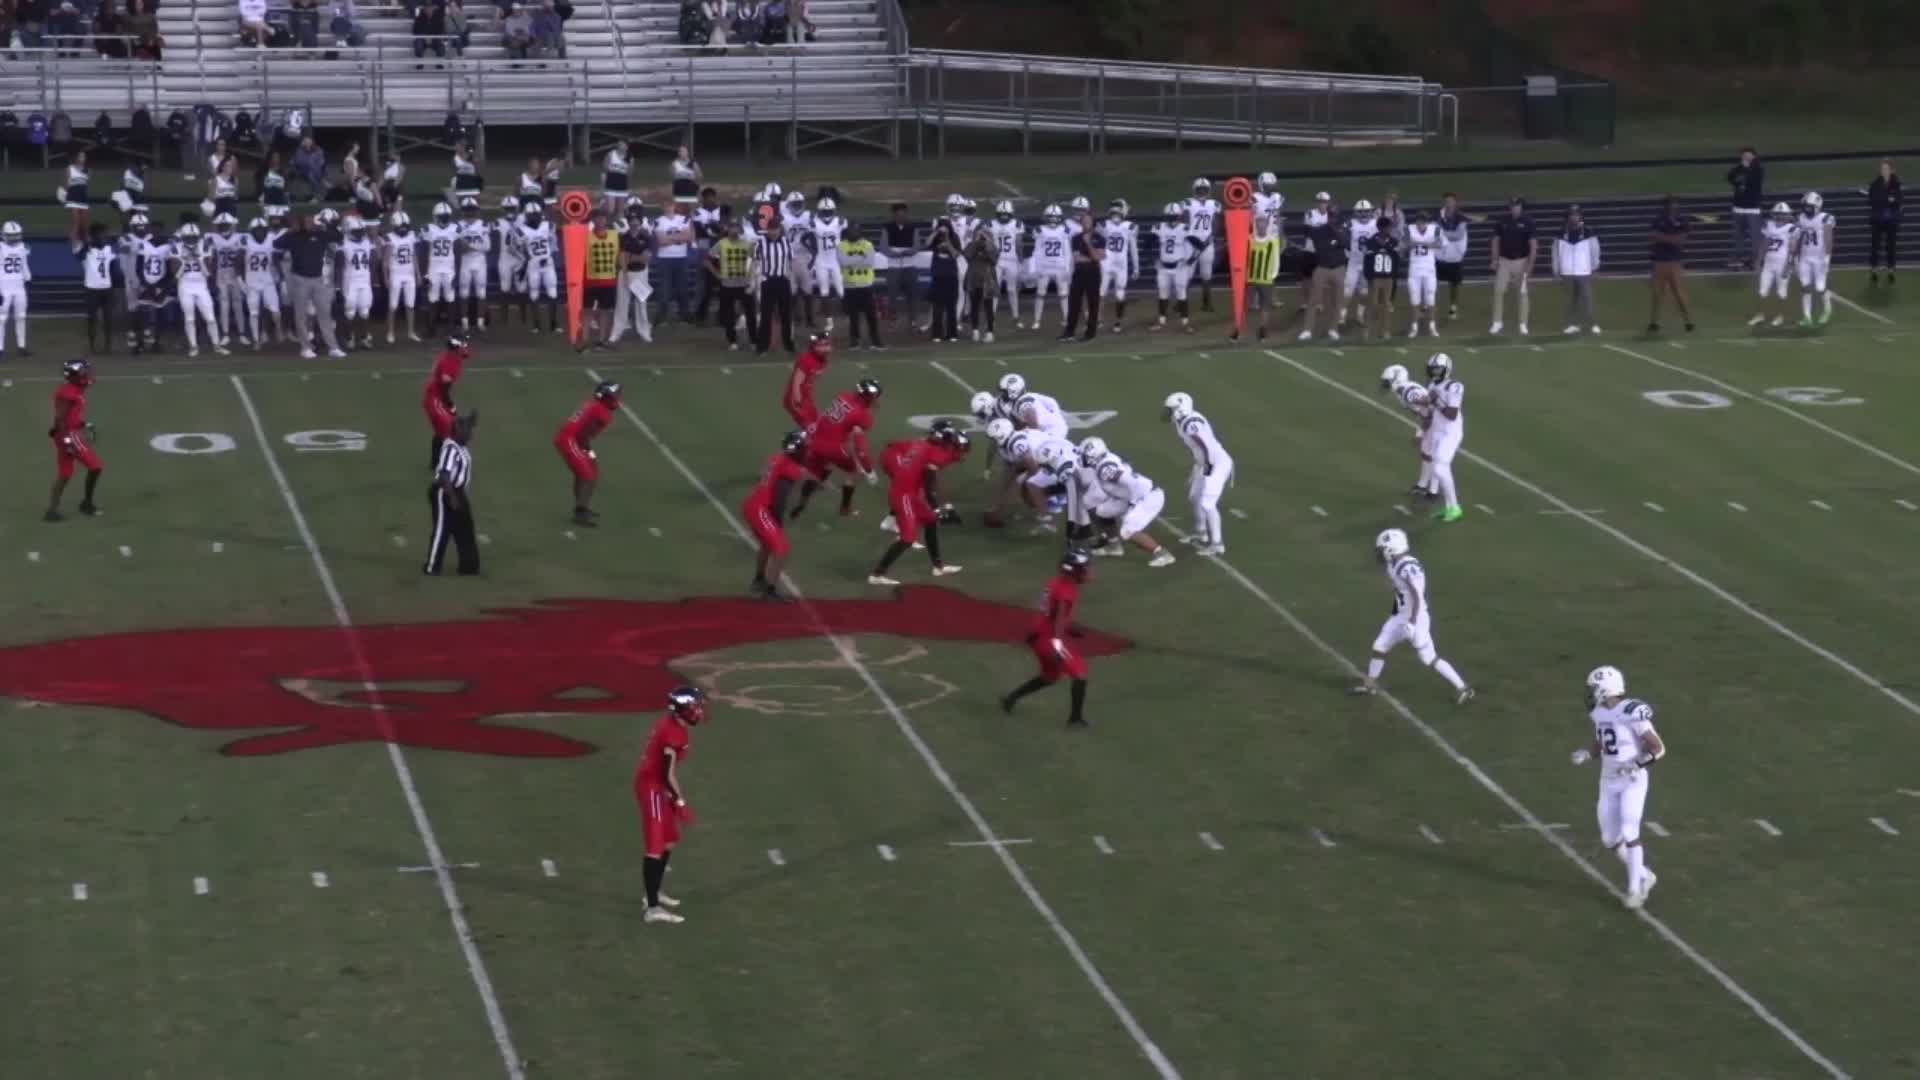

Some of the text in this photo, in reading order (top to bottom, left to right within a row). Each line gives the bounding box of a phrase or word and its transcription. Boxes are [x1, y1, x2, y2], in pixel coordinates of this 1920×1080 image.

[1194, 214, 1211, 231] 70
[433, 239, 451, 257] 55
[822, 235, 837, 250] 13
[999, 236, 1012, 253] 15
[1045, 241, 1061, 257] 22
[249, 256, 268, 271] 24
[351, 252, 369, 270] 44
[1597, 727, 1619, 755] 12
